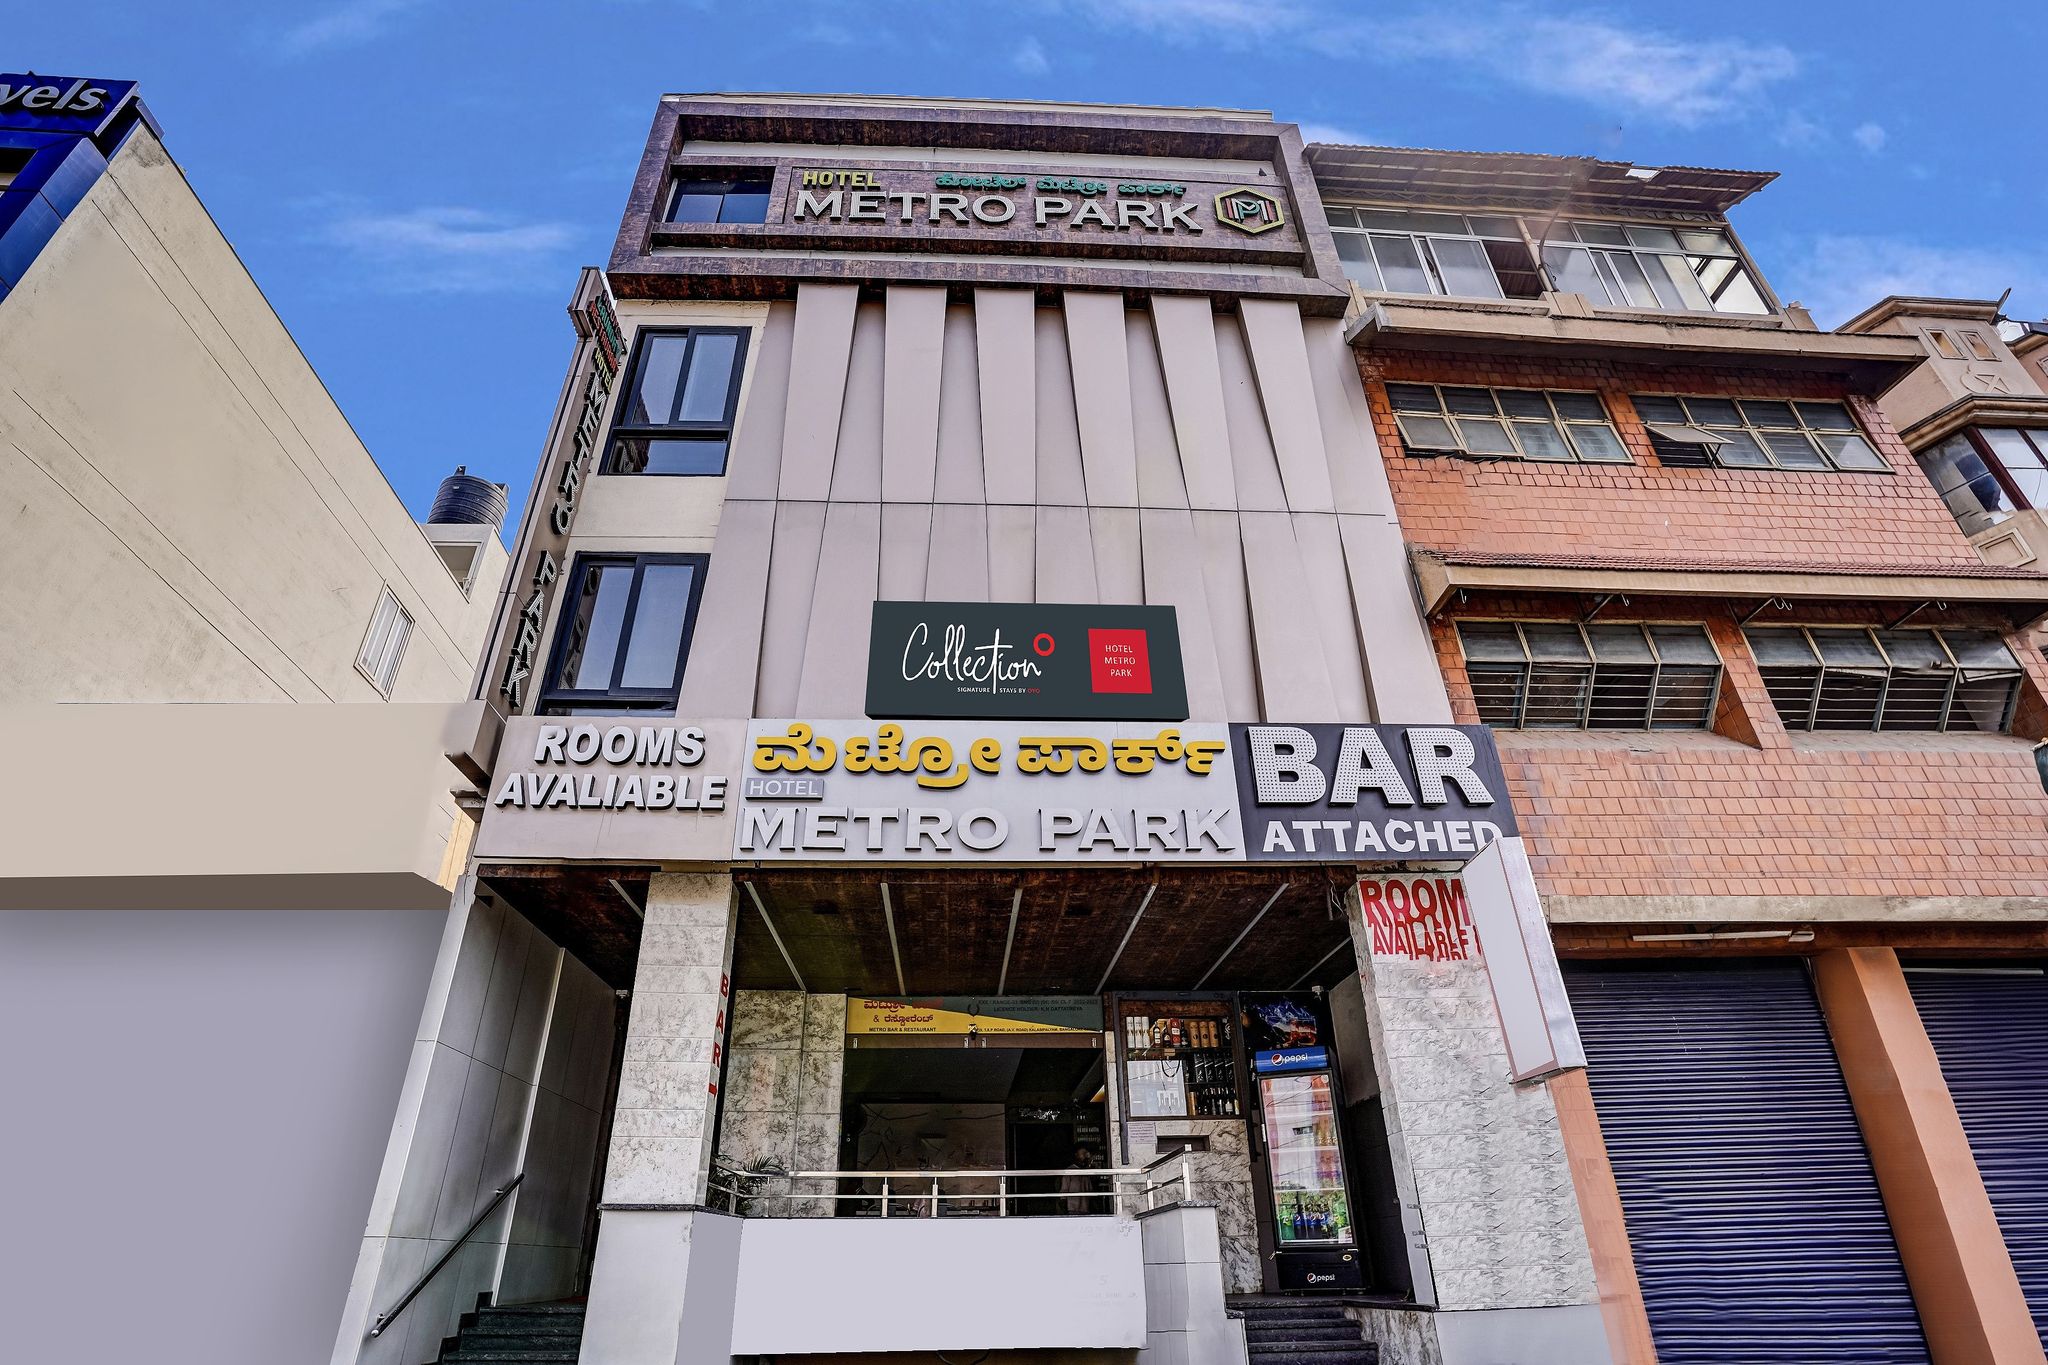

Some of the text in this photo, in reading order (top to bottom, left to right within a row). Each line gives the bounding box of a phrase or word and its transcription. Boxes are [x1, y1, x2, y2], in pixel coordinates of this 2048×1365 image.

[803, 171, 881, 188] HOTEL
[794, 190, 1203, 233] METRO PARK
[552, 372, 607, 536] METRO
[502, 550, 558, 707] PARK
[902, 622, 1042, 694] Collection
[1104, 656, 1136, 665] METRO
[1105, 644, 1133, 653] HOTEL
[1110, 668, 1133, 677] PARK
[534, 725, 705, 766] ROOMS
[1246, 726, 1496, 806] BAR
[494, 772, 728, 811] AVALIABLE
[750, 779, 818, 796] HOTEL
[740, 806, 1236, 852] METRO PARK
[1262, 820, 1504, 853] ATTACHED
[712, 972, 729, 1068] BAR
[1284, 1052, 1308, 1064] pepsi
[1317, 1273, 1336, 1283] pepsi
